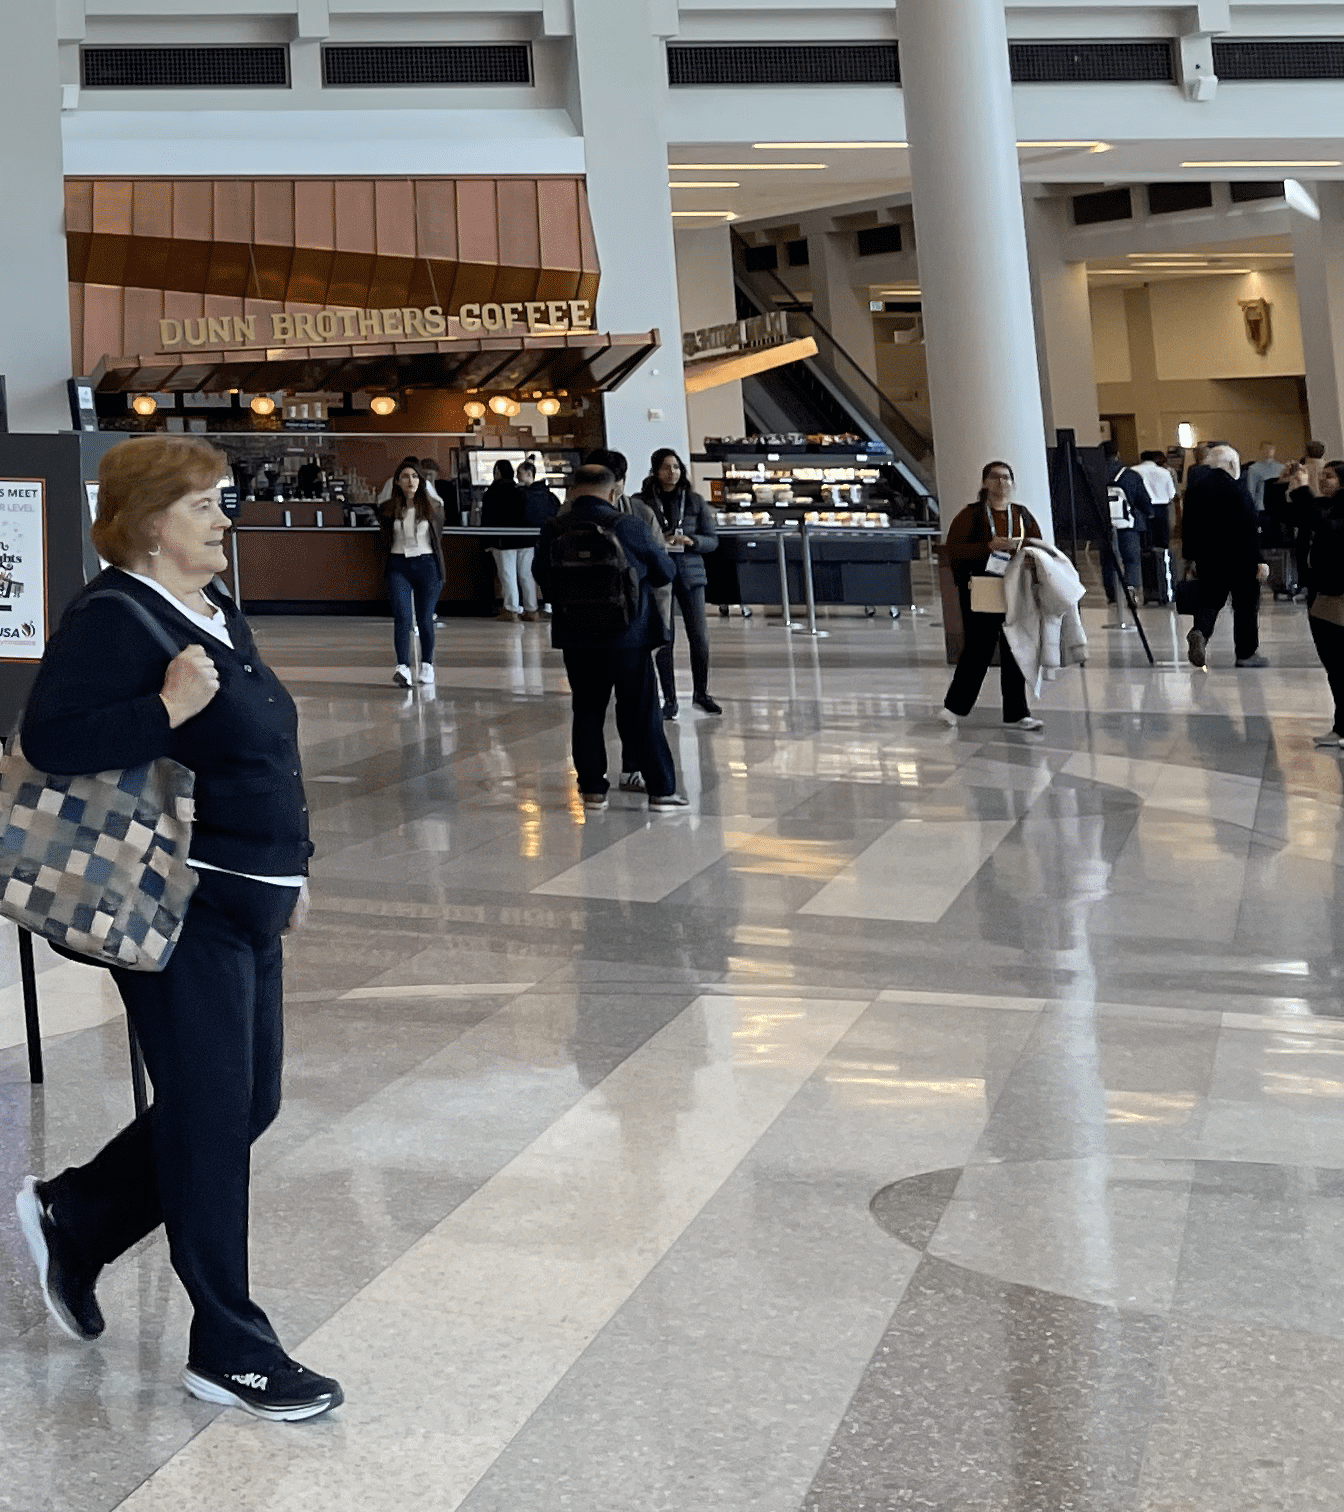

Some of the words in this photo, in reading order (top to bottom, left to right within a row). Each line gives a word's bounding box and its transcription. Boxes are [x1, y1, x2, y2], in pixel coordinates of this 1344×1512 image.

[159, 315, 257, 347] DUNN
[270, 306, 447, 343] BROTHERS
[458, 299, 591, 331] COFFEE
[7, 488, 39, 498] MEET
[7, 503, 35, 513] LEVEL
[230, 1372, 269, 1391] OKA
